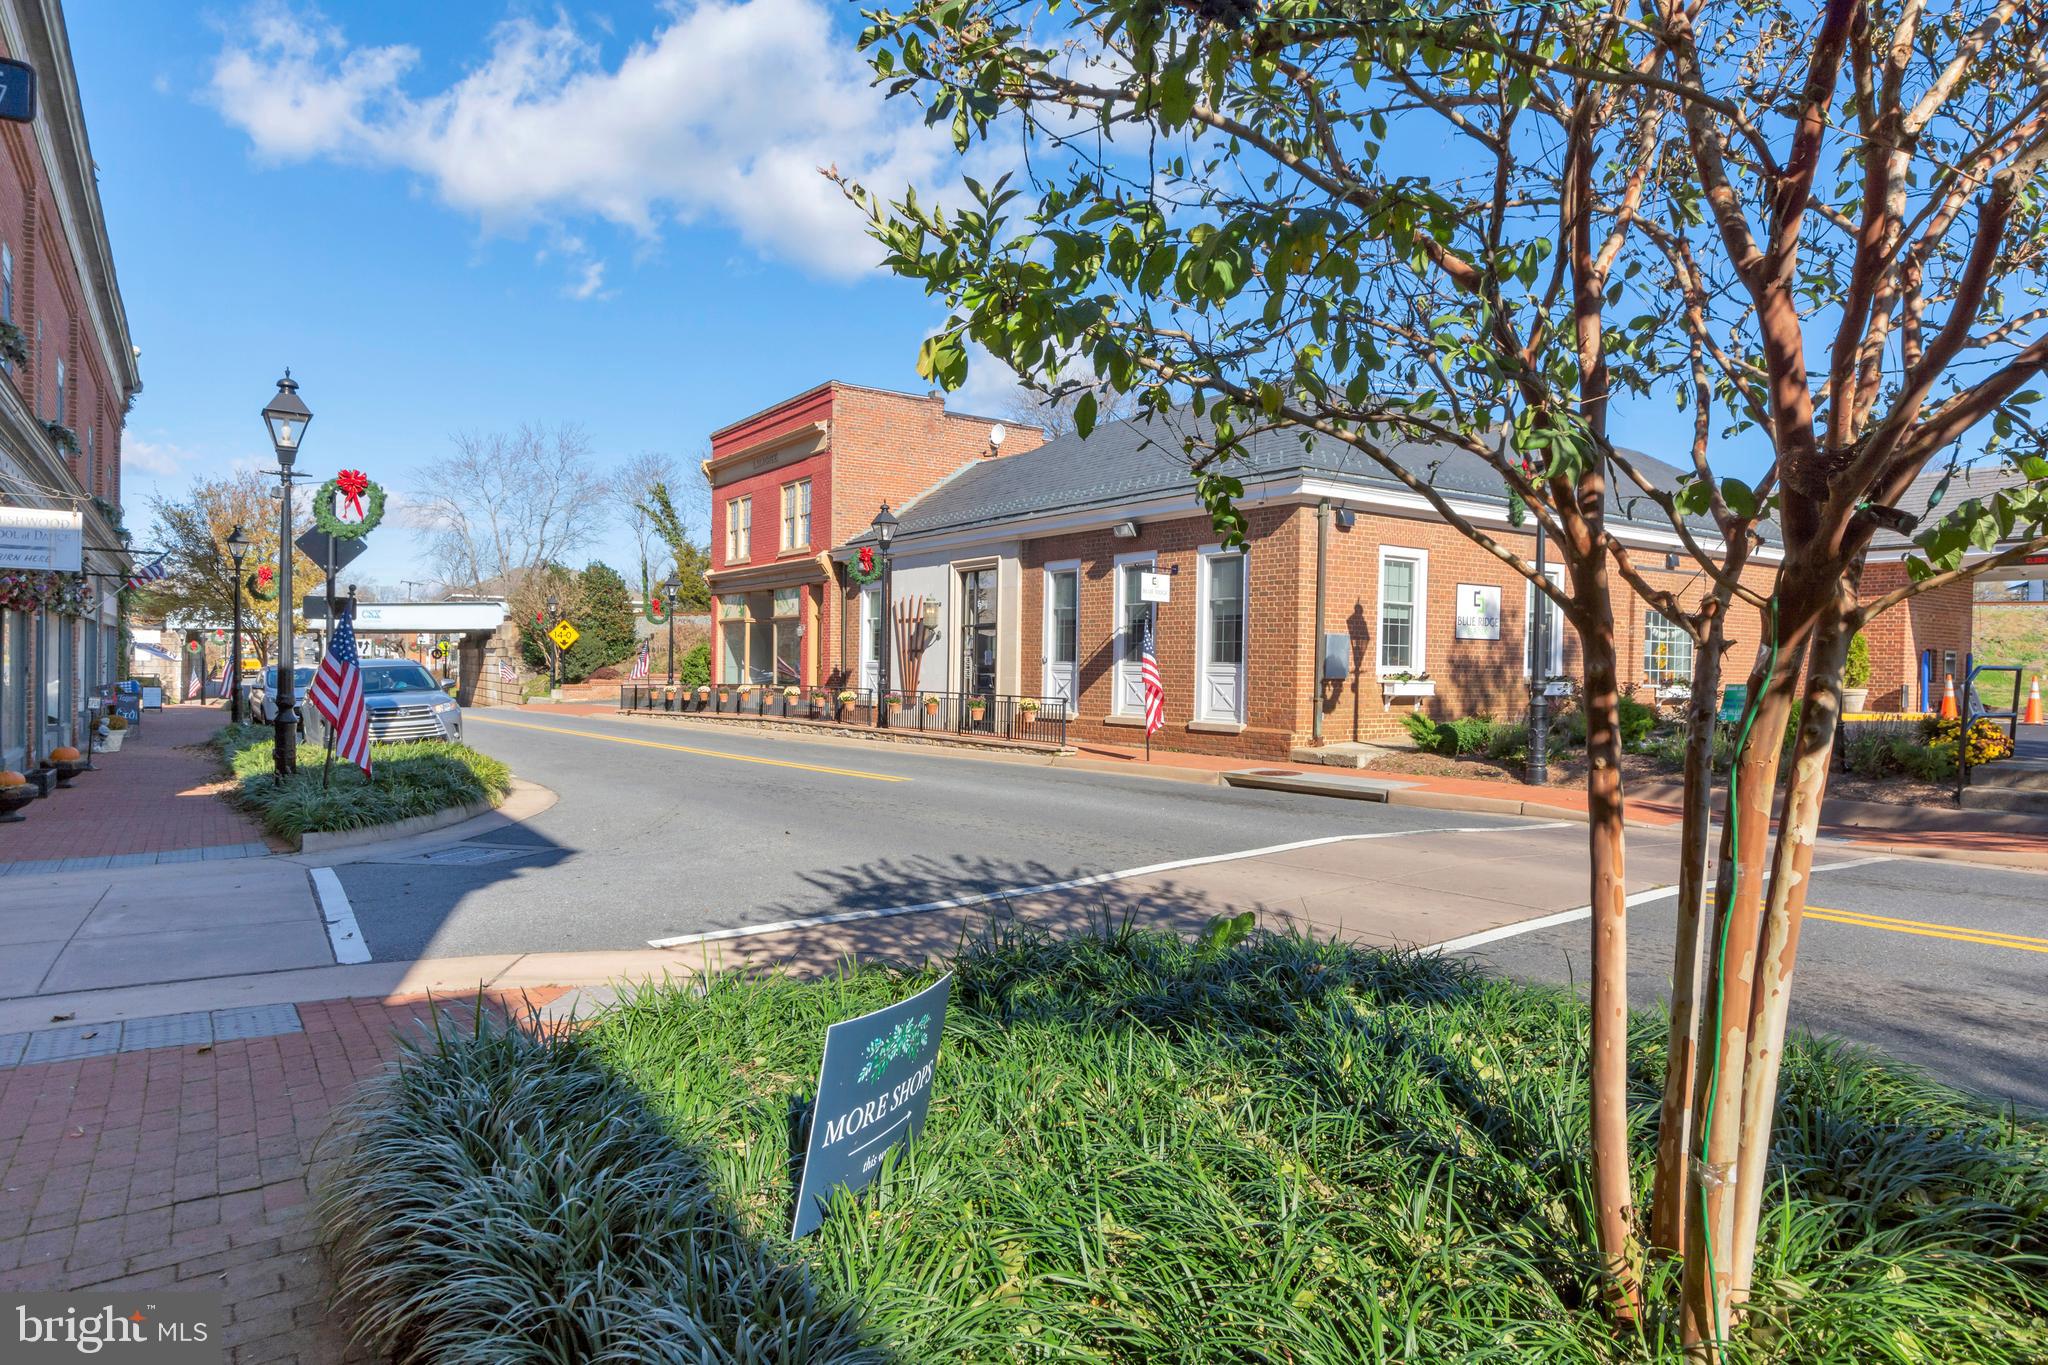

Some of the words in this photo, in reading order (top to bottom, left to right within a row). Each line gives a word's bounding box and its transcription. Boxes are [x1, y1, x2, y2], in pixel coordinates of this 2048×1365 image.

[361, 609, 382, 620] CSX
[1457, 615, 1476, 627] BLUE
[1477, 616, 1499, 628] RIDGE
[822, 1093, 889, 1149] MORE
[890, 1059, 934, 1112] SHOPS
